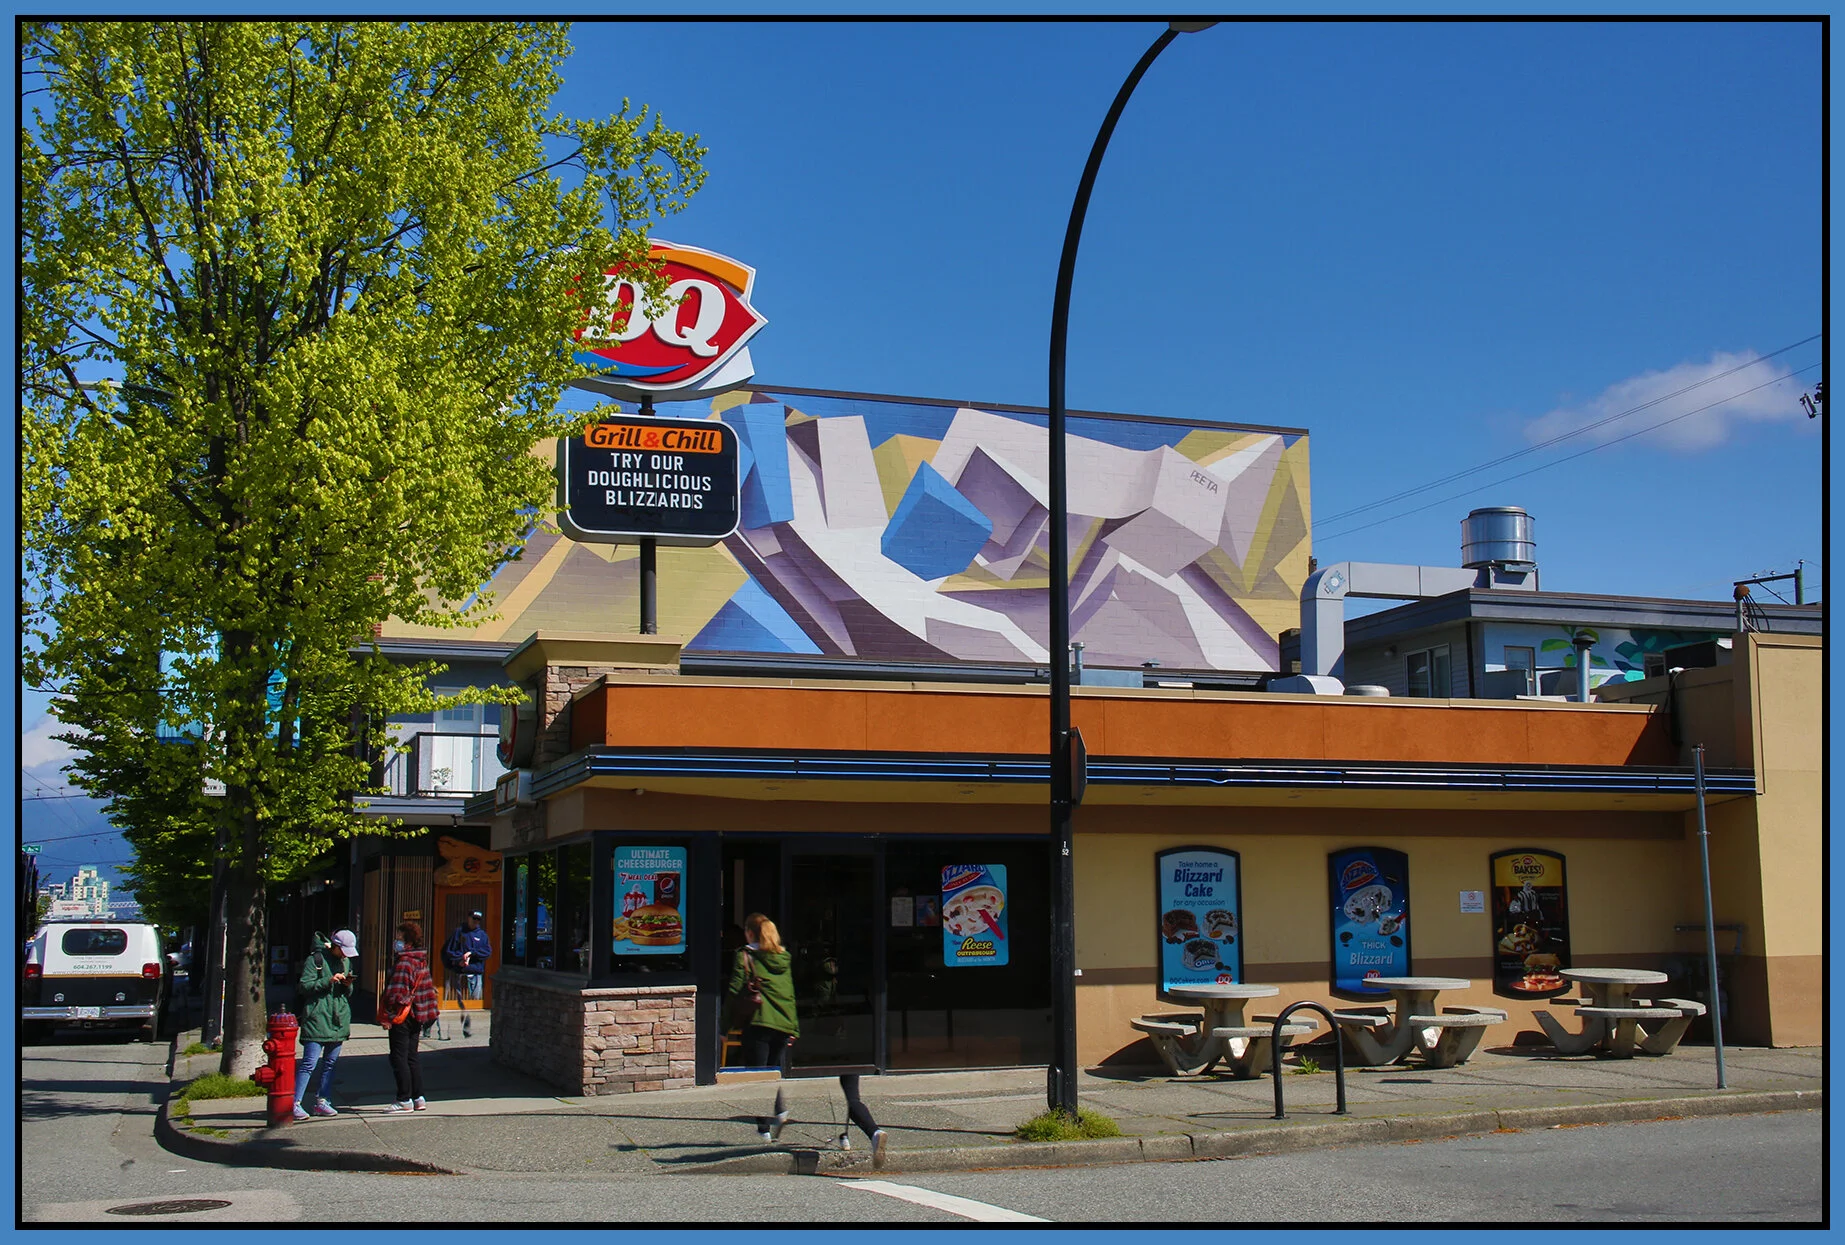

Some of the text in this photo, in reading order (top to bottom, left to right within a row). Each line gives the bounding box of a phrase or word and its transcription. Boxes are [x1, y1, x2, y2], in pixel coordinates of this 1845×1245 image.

[581, 274, 726, 357] DQ
[611, 452, 684, 472] TRY OUR
[588, 470, 712, 492] DOUGHLICIOUS
[1190, 470, 1218, 494] PEETA
[605, 489, 704, 510] BLIZZARDS
[630, 849, 670, 859] ULTIMATE
[618, 859, 683, 869] CHEESEBURGER
[1514, 865, 1541, 874] BAKES!
[1173, 868, 1224, 882] Blizzard
[1184, 883, 1213, 897] Cake
[1173, 899, 1184, 907] for
[1361, 941, 1386, 949] THICK
[1349, 952, 1394, 966] Blizzard
[1217, 976, 1231, 985] DQ
